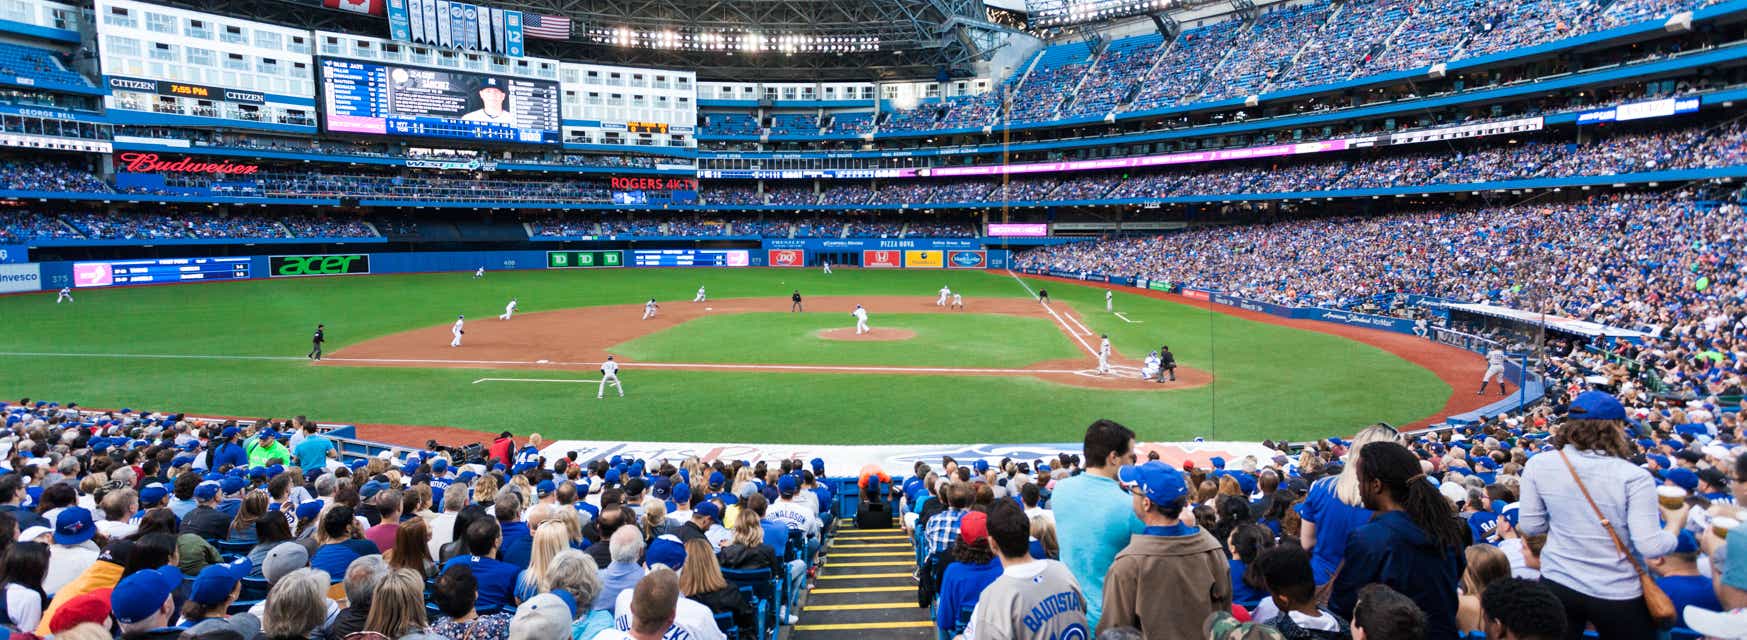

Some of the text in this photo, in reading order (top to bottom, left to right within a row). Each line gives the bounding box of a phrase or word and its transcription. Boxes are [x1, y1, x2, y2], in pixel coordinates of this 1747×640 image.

[508, 31, 521, 42] 12
[111, 79, 155, 91] CITIZEN
[170, 84, 207, 96] 7:55 PM
[225, 91, 264, 103] CITIZEN
[19, 108, 54, 117] GEORGE
[120, 152, 258, 175] Budweiser
[611, 178, 699, 190] ROGERS 4K TV
[780, 254, 794, 262] DQ
[279, 255, 361, 274] acer
[1023, 591, 1081, 633] BAUTISTA
